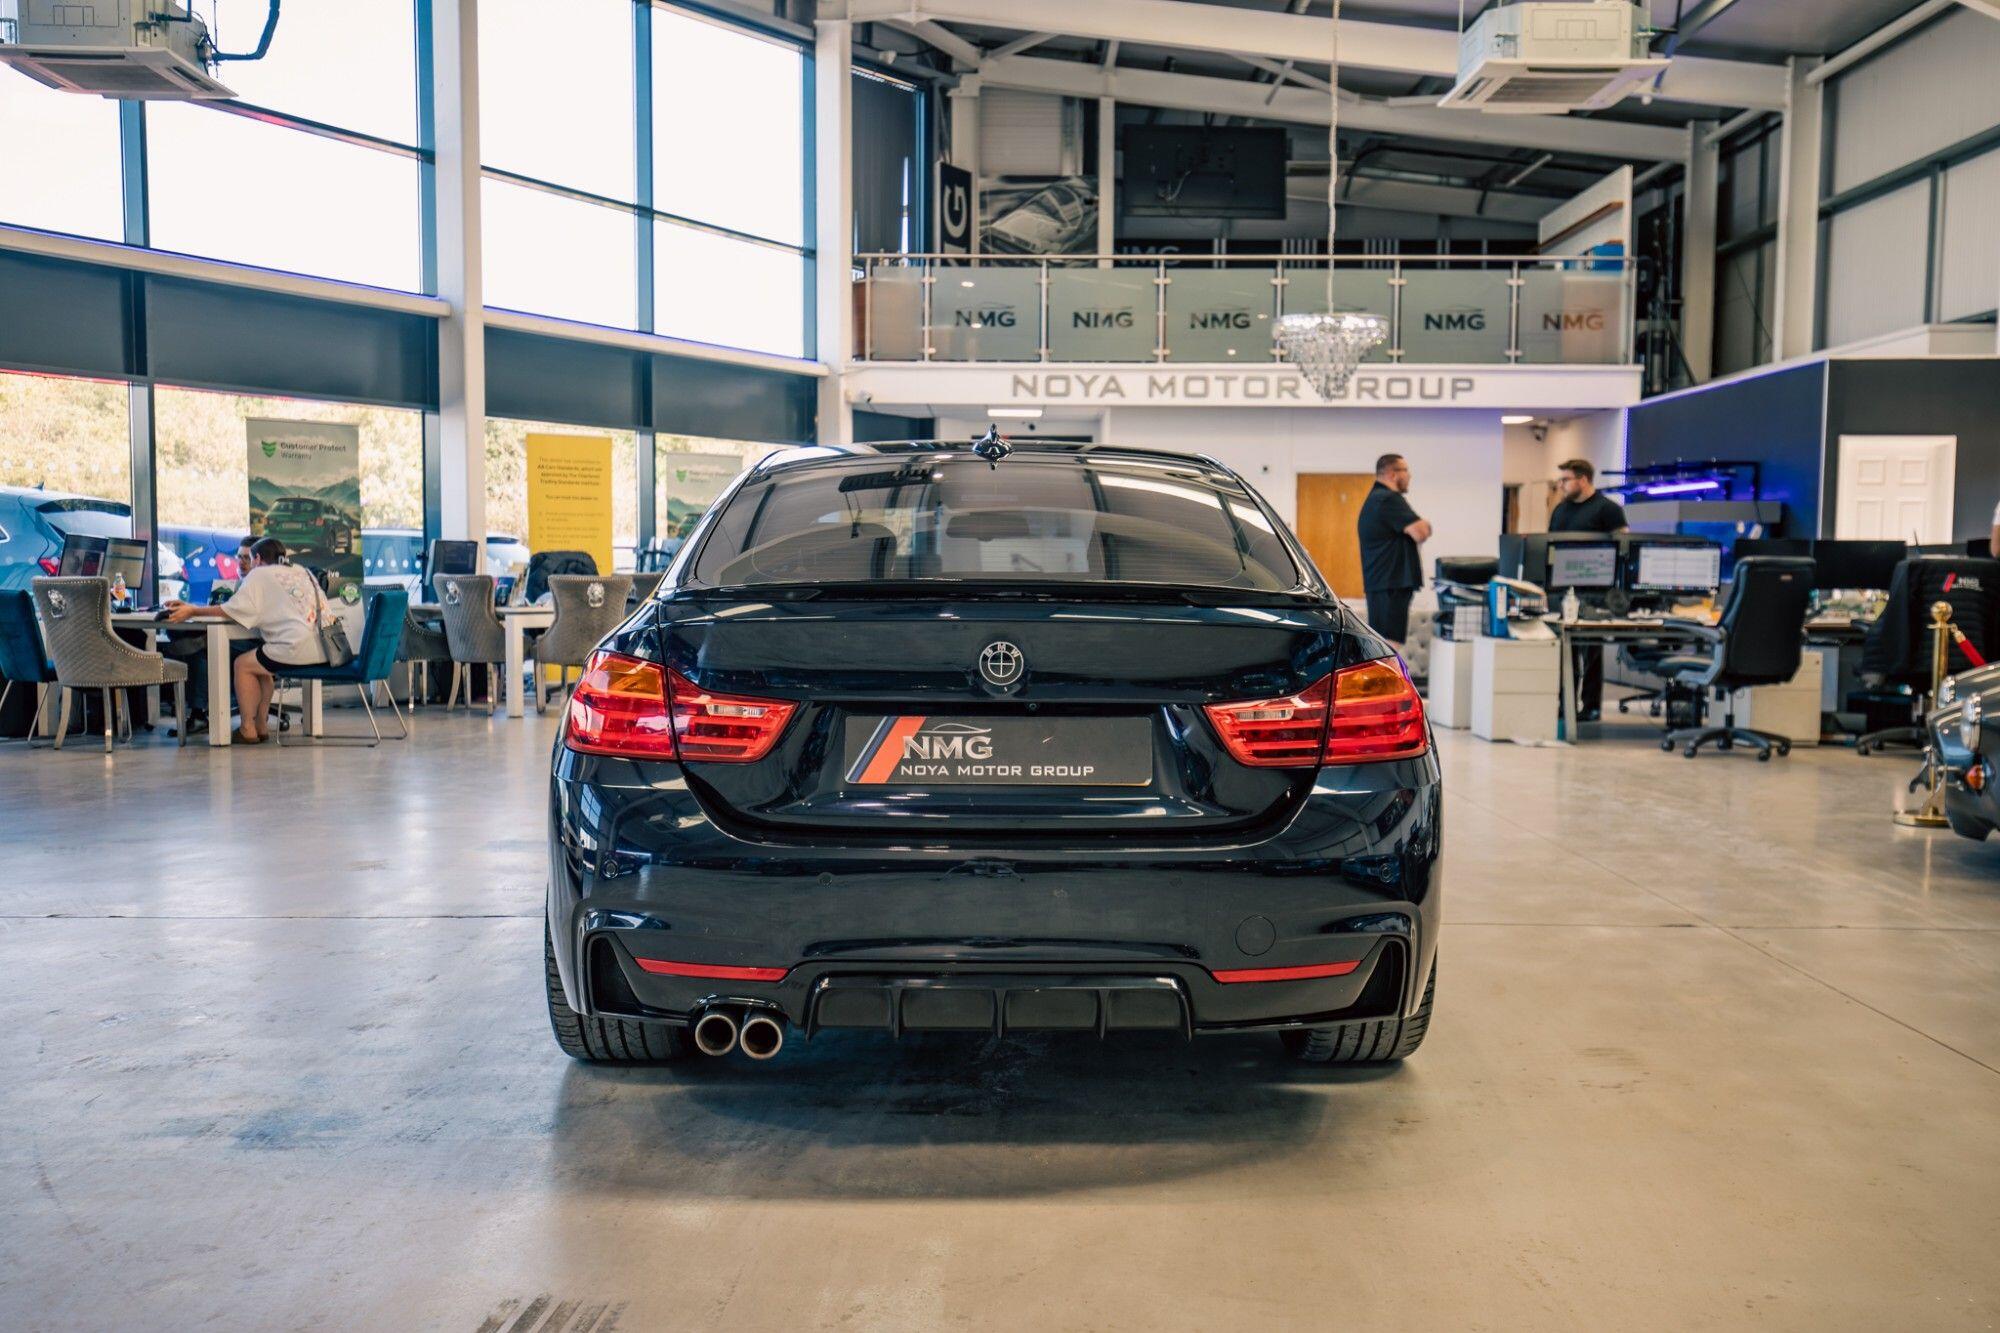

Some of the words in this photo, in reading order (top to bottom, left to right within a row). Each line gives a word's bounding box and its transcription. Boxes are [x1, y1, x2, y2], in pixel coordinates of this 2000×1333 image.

[955, 310, 1016, 328] NMG
[1072, 311, 1134, 328] NMG
[1190, 312, 1251, 329] NMG
[1424, 313, 1486, 331] NMG
[1542, 313, 1605, 331] NMG
[1012, 374, 1126, 399] NOYA
[1149, 375, 1301, 399] MOTOR
[319, 443, 346, 452] Protect
[983, 642, 1021, 658] BMW
[903, 735, 993, 760] NMG
[901, 765, 949, 776] NOYA
[957, 765, 1022, 777] MOTOR
[1030, 765, 1095, 777] GROUP
